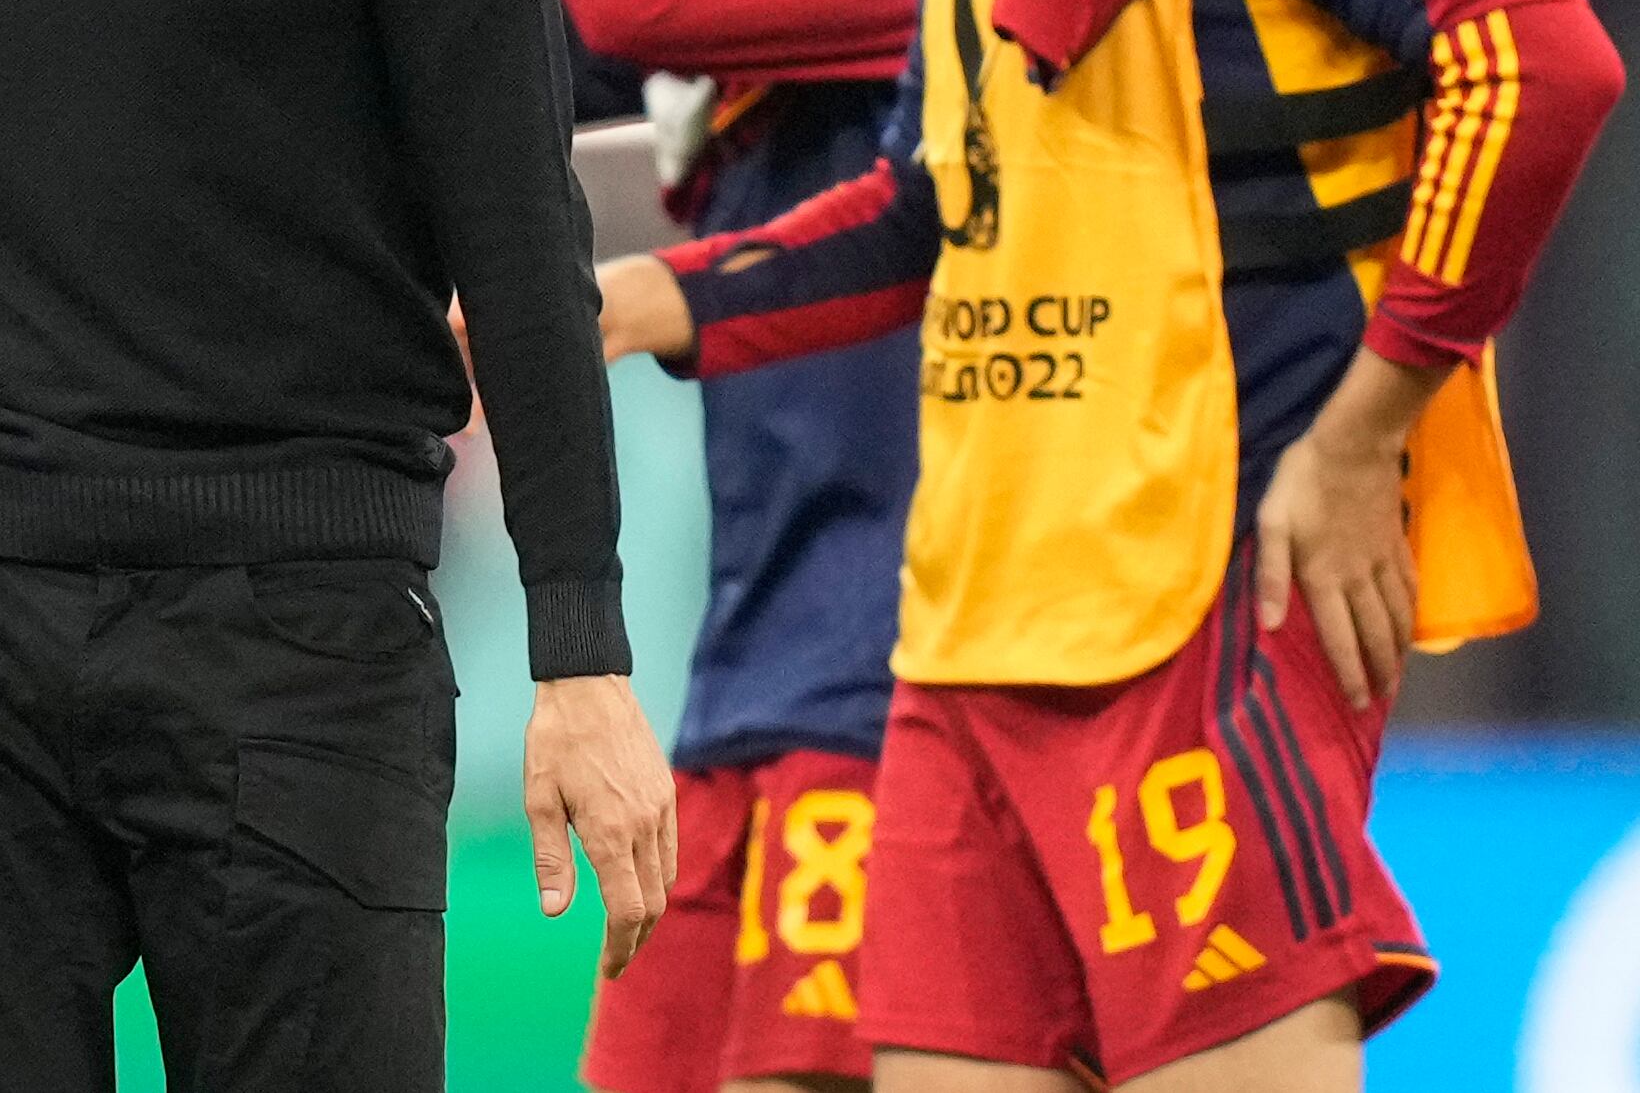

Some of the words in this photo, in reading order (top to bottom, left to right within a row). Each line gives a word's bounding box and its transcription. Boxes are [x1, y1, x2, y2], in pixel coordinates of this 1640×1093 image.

[1026, 293, 1110, 338] CUP
[735, 788, 875, 966] 18
[1087, 747, 1236, 954] 19
